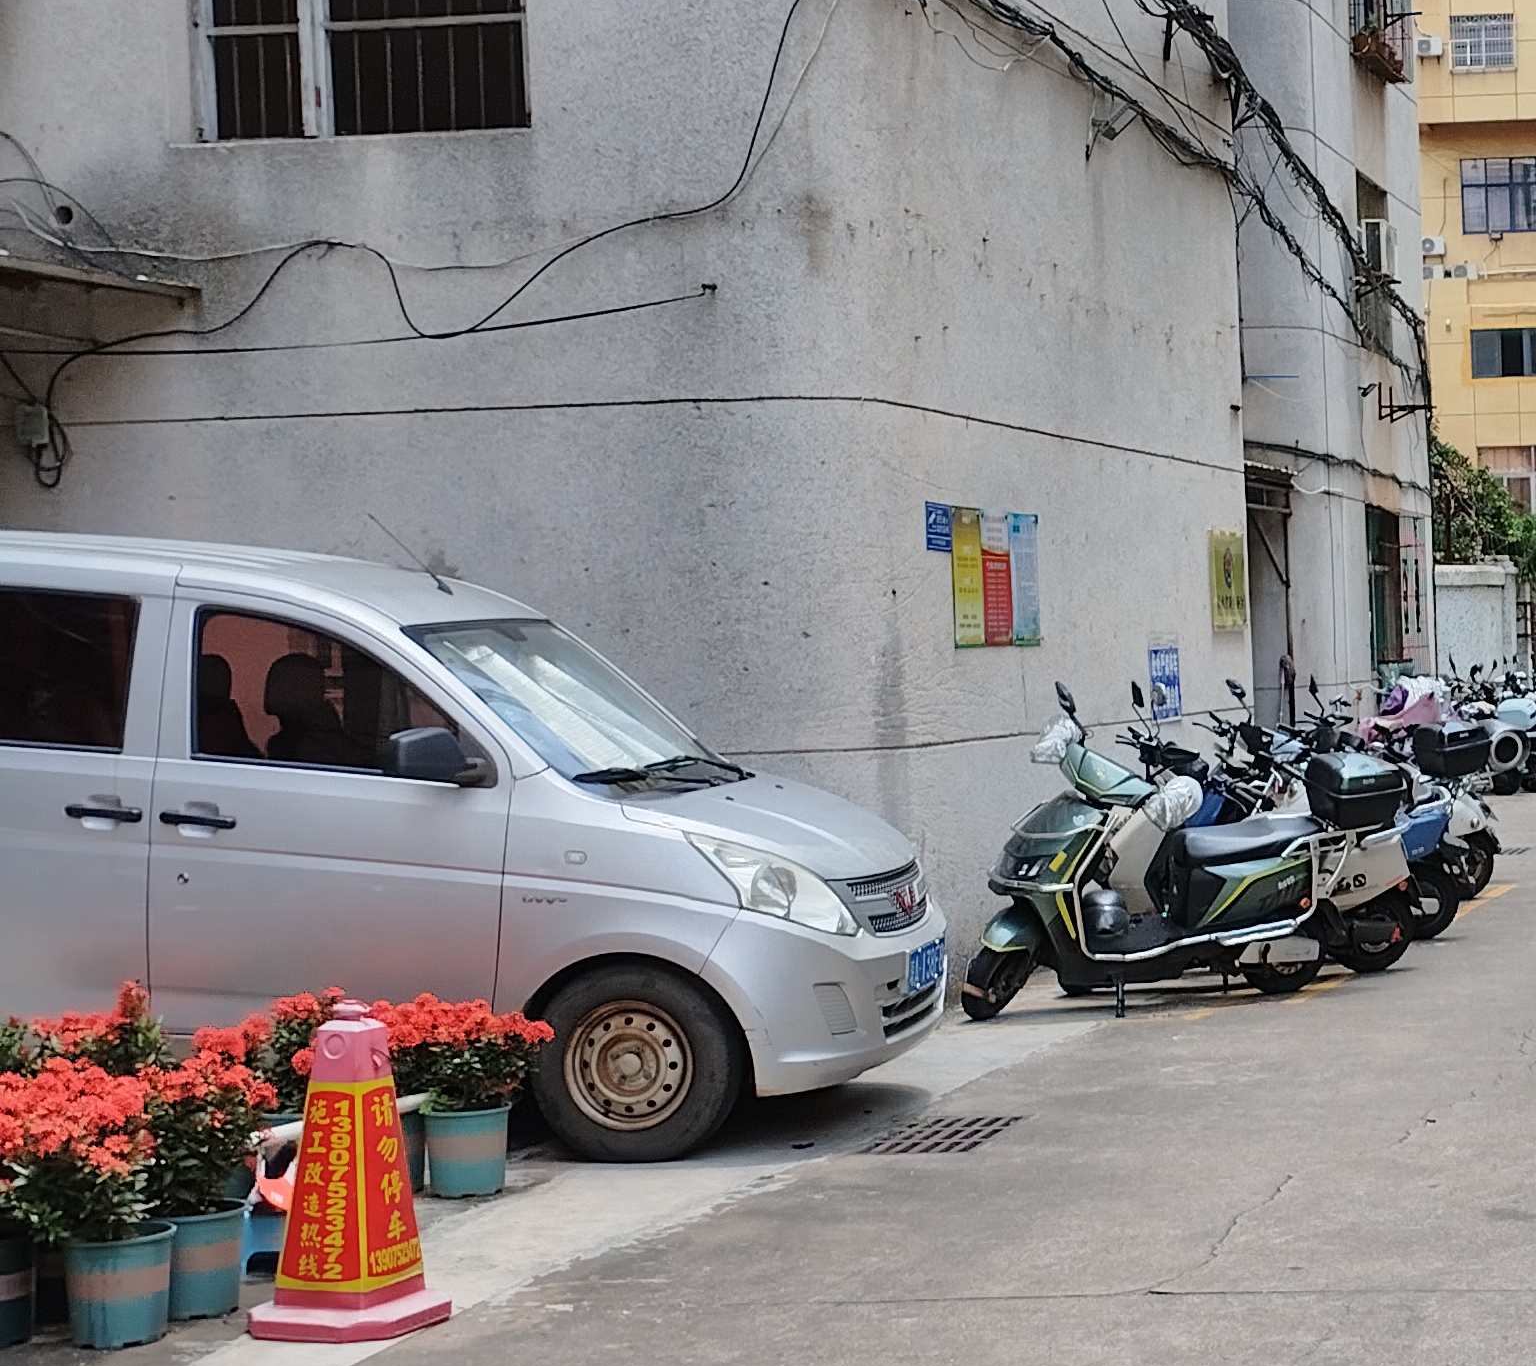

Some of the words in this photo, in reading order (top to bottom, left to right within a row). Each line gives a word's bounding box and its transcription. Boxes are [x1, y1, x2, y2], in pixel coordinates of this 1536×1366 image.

[298, 1099, 330, 1279] 施工改造热线
[322, 1100, 352, 1280] 13907523472
[370, 1092, 407, 1241] 请勿停车
